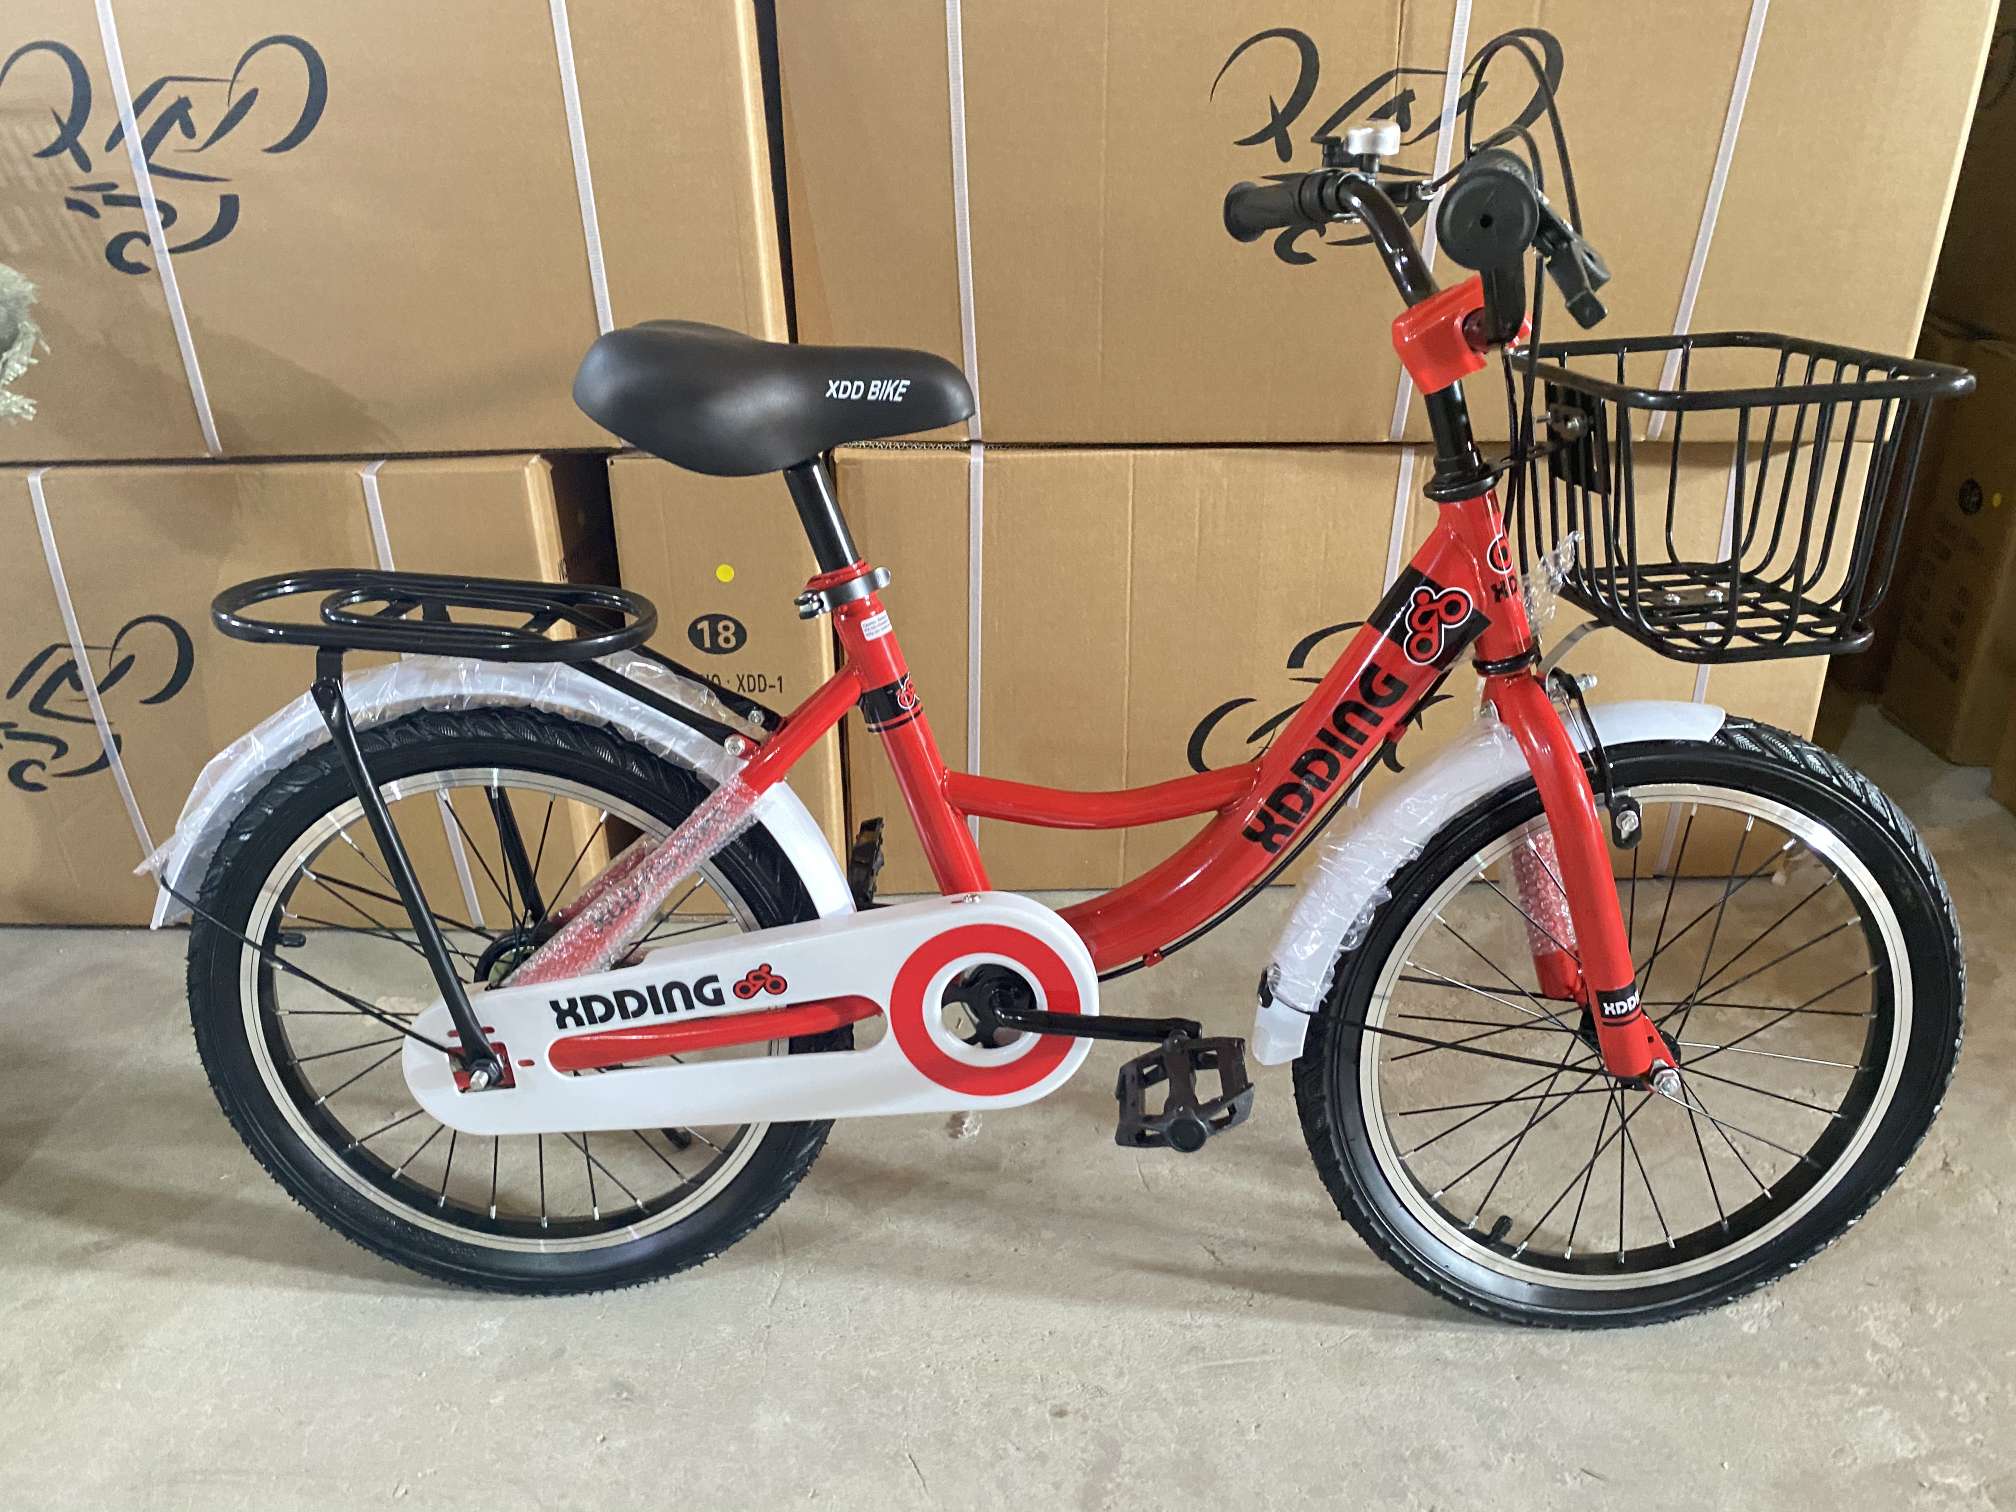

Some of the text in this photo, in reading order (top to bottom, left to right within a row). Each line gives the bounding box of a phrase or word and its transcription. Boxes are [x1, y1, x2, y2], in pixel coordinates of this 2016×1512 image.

[825, 379, 911, 402] XDD BIKE
[696, 619, 737, 649] 18
[736, 674, 783, 694] XDD-1
[1242, 661, 1409, 854] XDDING
[548, 973, 726, 1030] XDDING
